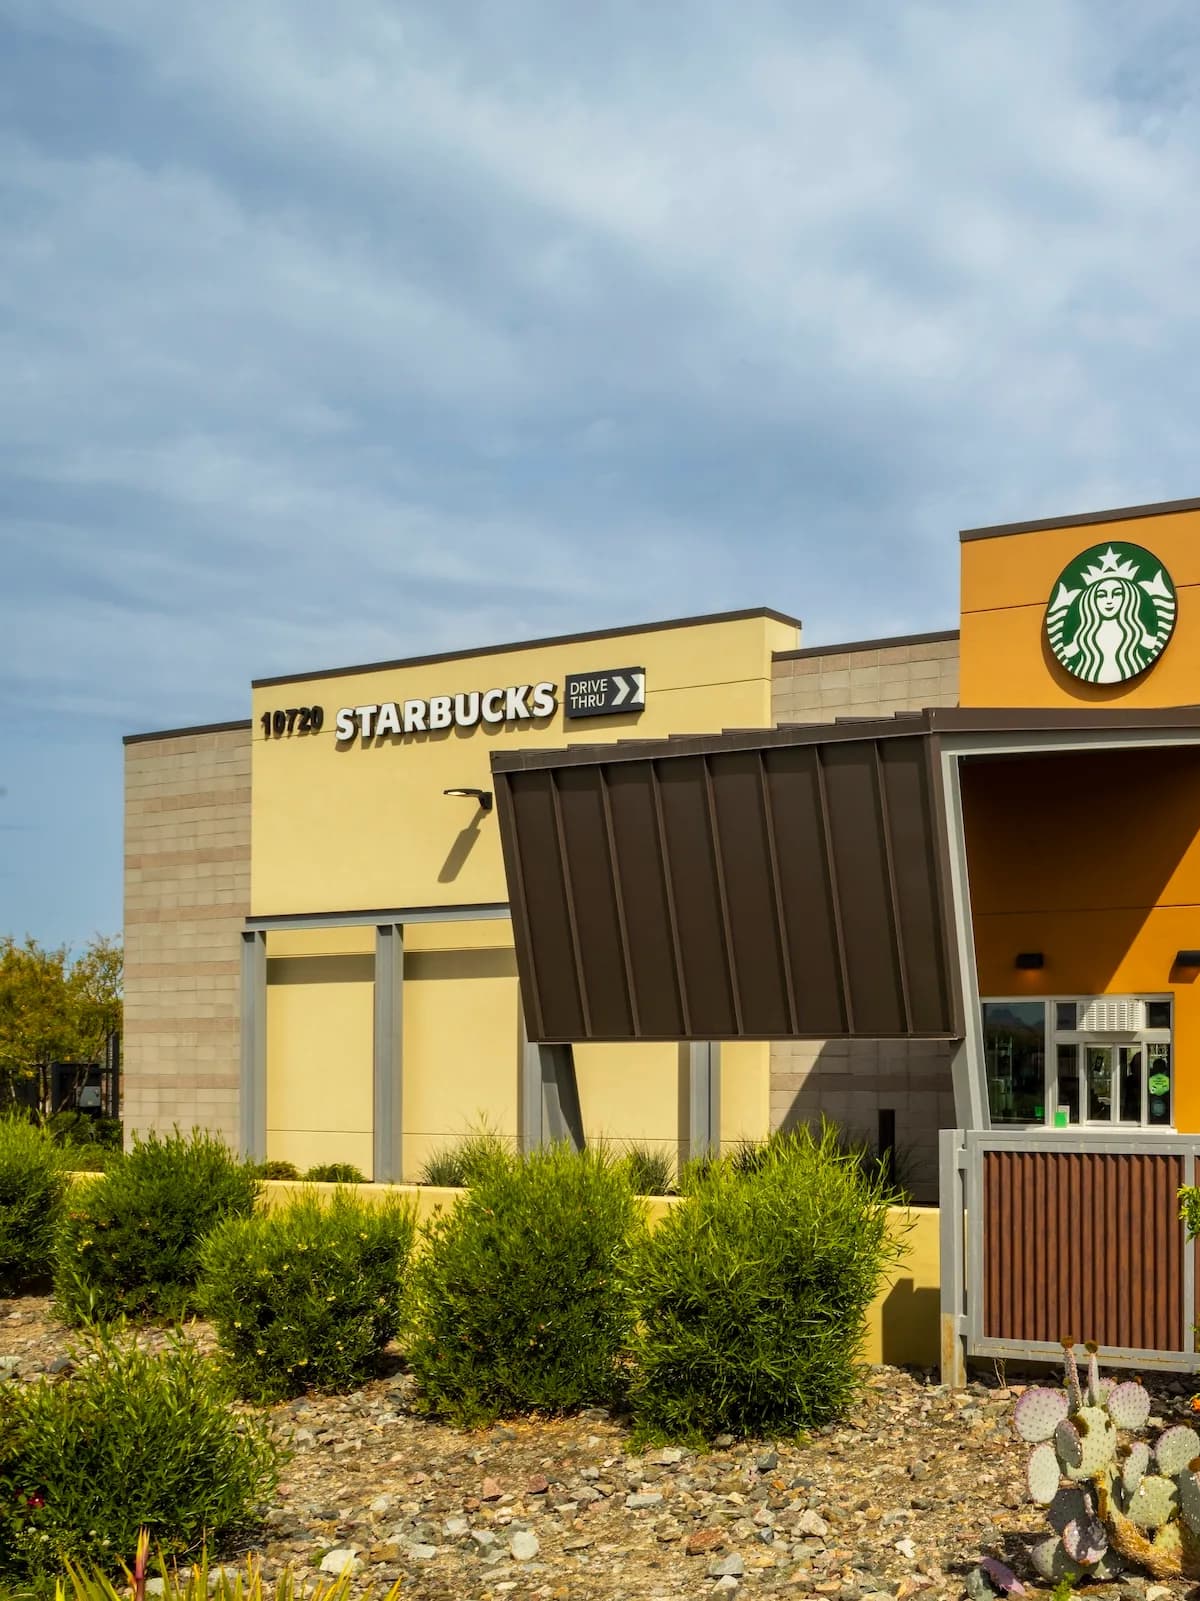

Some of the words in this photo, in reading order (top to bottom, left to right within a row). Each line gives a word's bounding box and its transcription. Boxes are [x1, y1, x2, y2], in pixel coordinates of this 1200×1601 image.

[570, 678, 608, 696] DRIVE
[335, 682, 557, 741] STARBUCKS
[570, 693, 605, 709] THRU
[261, 705, 324, 738] 10720
